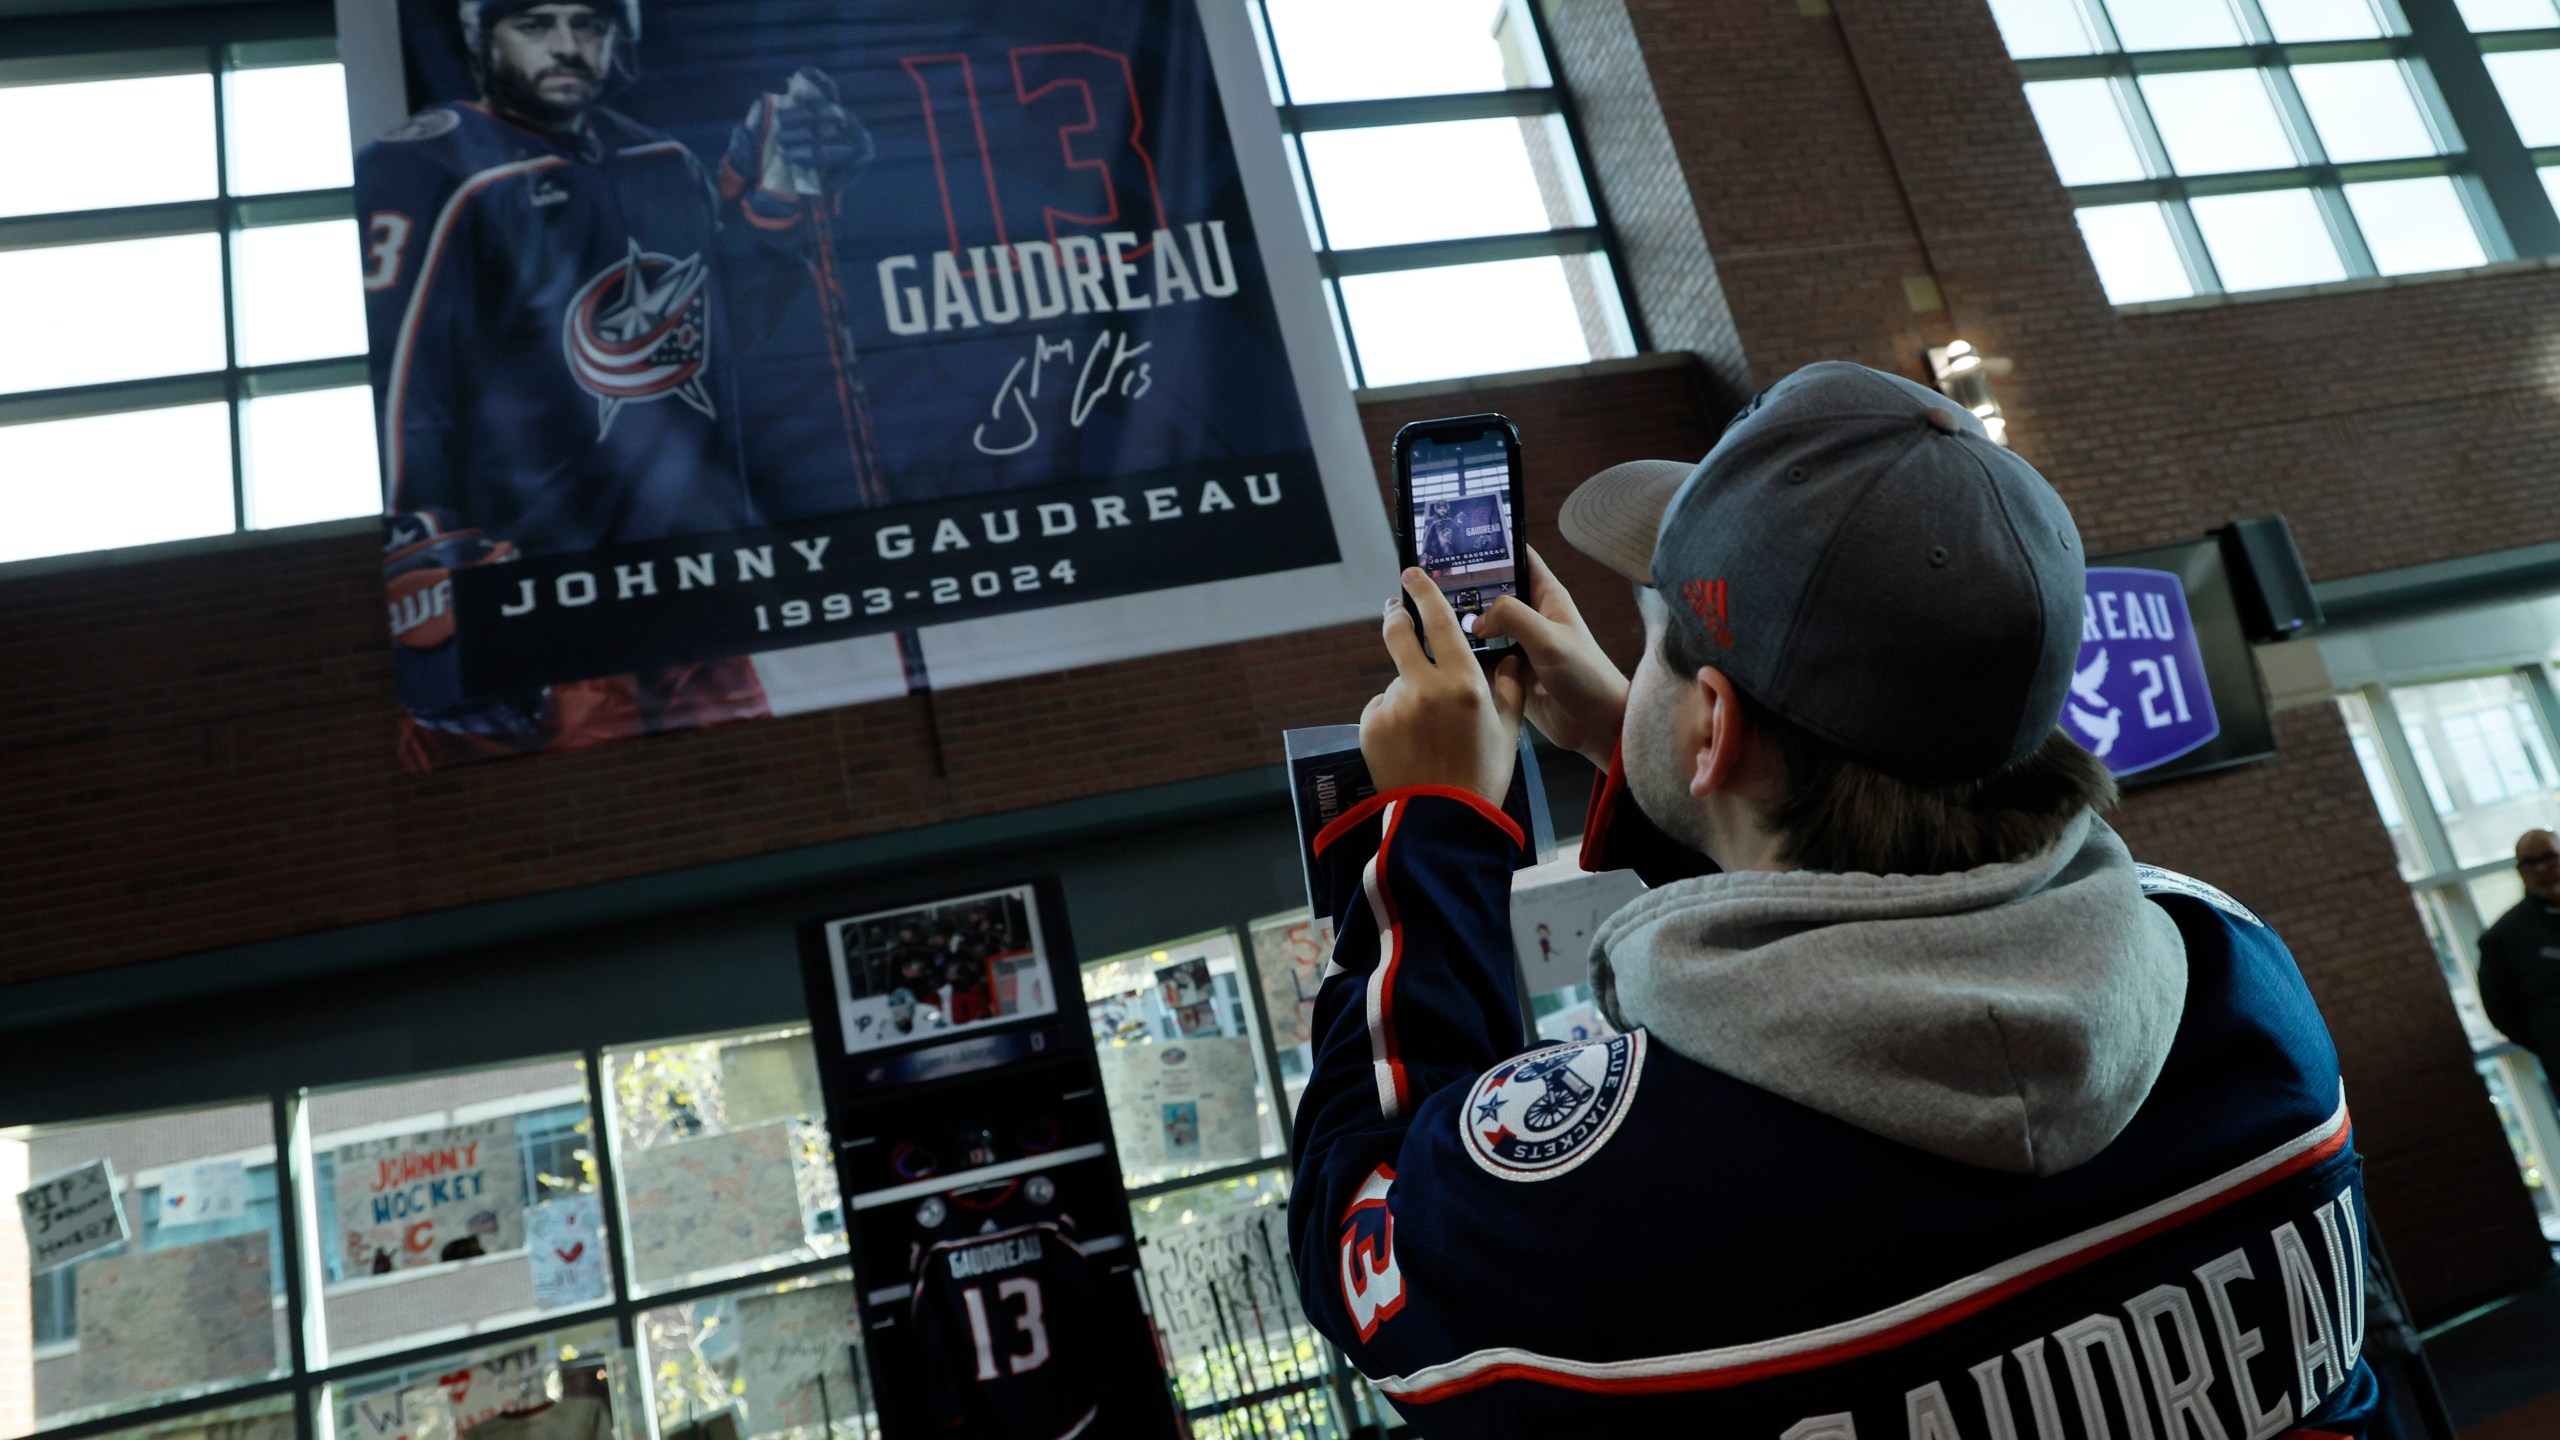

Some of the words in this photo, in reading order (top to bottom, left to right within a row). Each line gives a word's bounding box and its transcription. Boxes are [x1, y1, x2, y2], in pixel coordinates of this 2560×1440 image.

[902, 42, 1168, 278] 13
[877, 219, 1239, 335] GAUDREAU
[501, 535, 831, 617] JOHNNY
[876, 472, 1283, 560] GAUDREAU
[755, 557, 1078, 632] 1993-2024
[2129, 654, 2193, 729] 21
[1605, 1039, 1626, 1088] BLUE
[1512, 1097, 1607, 1160] JACKETS
[370, 1141, 478, 1193] JOHNNY
[372, 1169, 486, 1225] HOCKEY
[948, 1234, 1042, 1279] GAUDREAU
[962, 1276, 1050, 1381] 13
[1779, 1185, 2366, 1440] UDREAU
